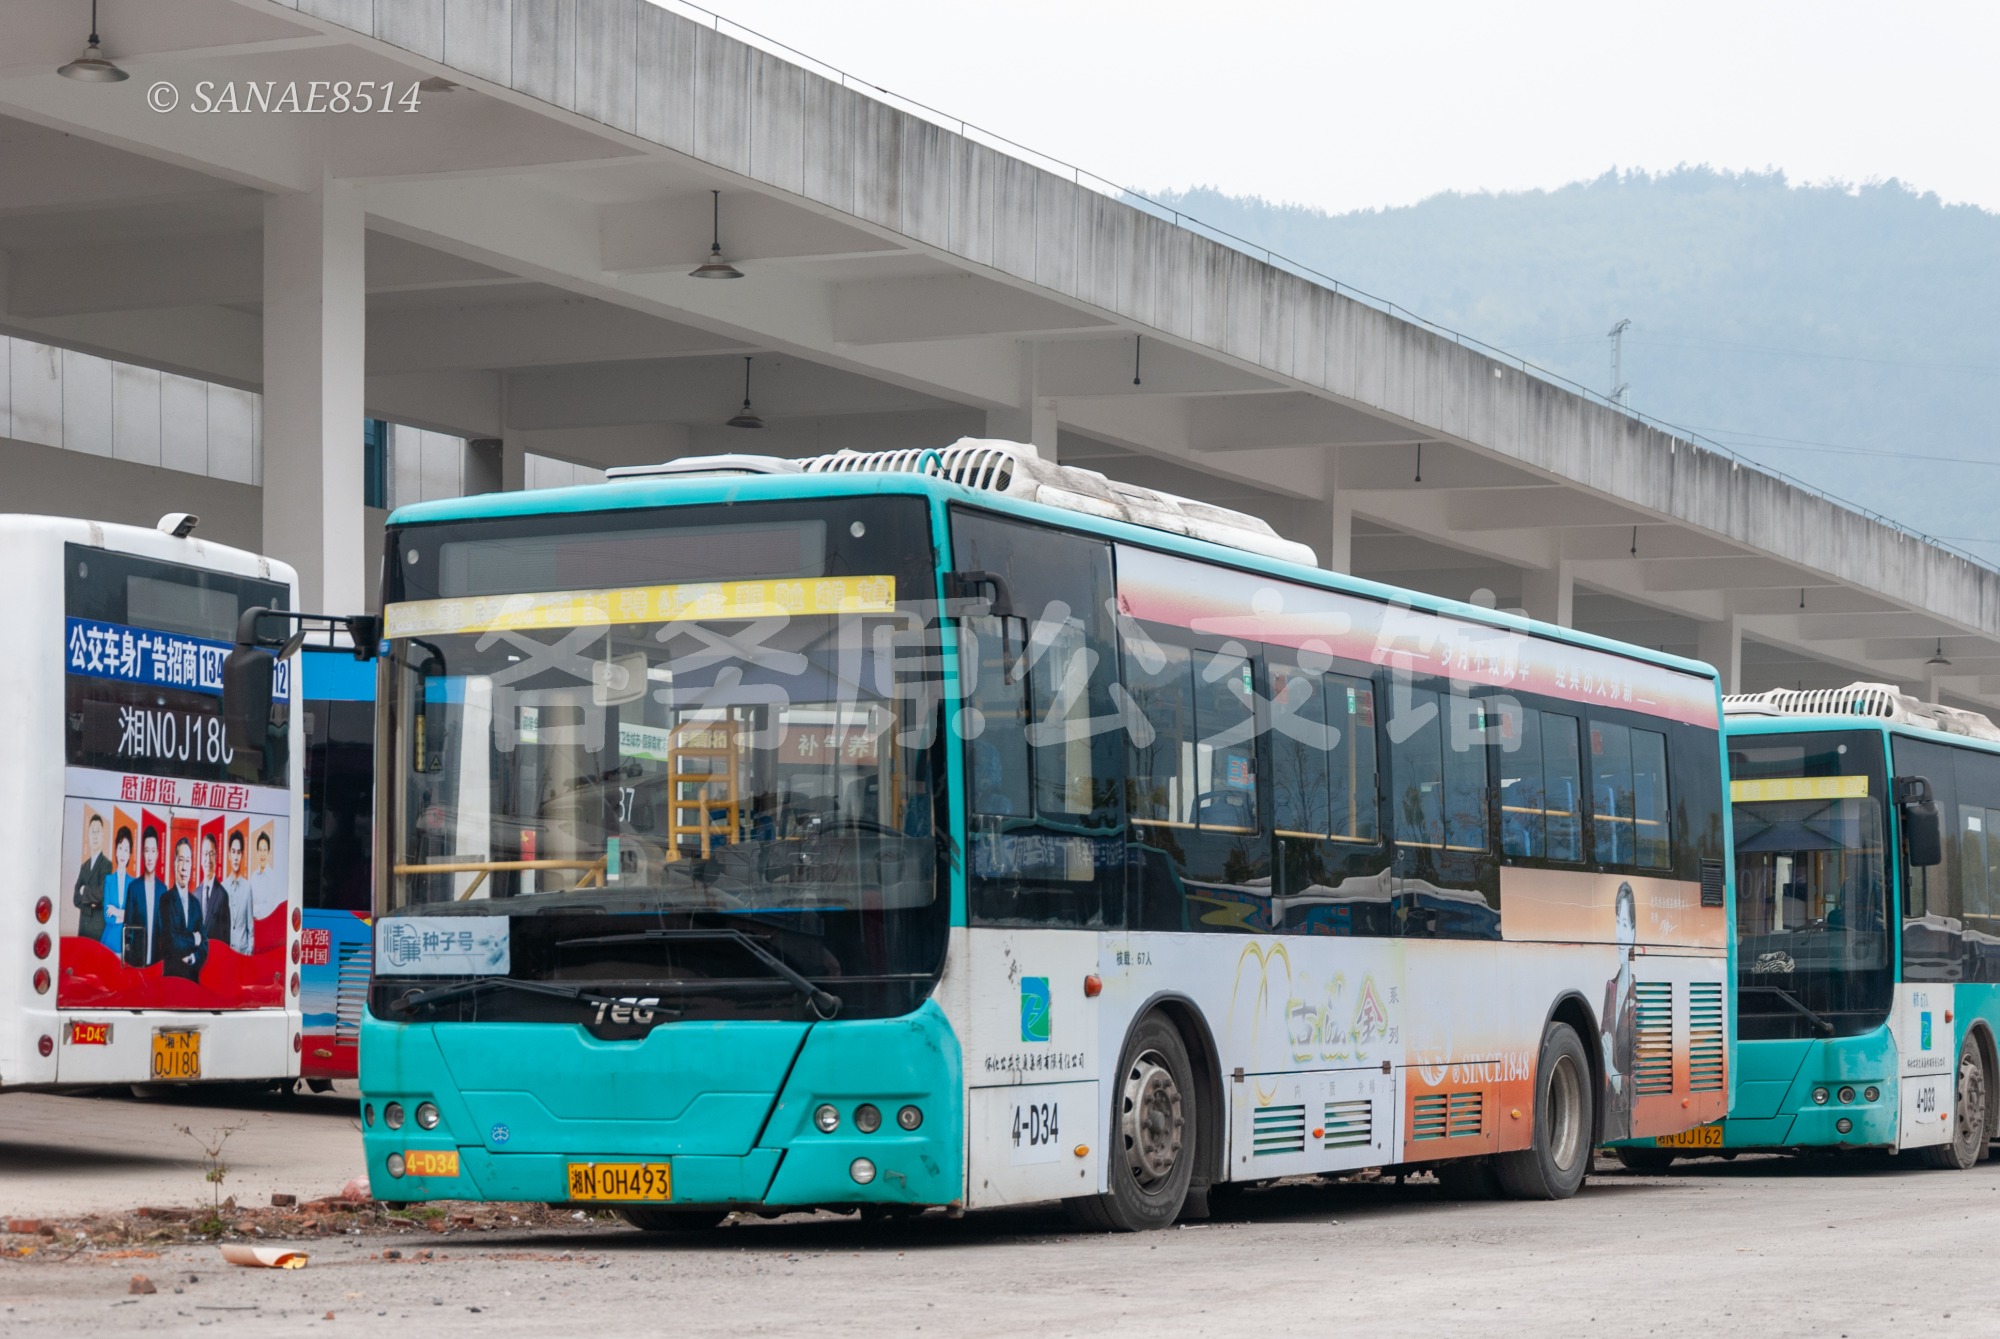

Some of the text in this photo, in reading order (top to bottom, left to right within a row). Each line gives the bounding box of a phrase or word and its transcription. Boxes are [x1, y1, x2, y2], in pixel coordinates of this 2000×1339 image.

[69, 624, 197, 687] 公交车身广告招商
[423, 931, 475, 952] 种子号
[1012, 1102, 1059, 1148] 4-D34
[406, 1153, 458, 1174] 4-D34
